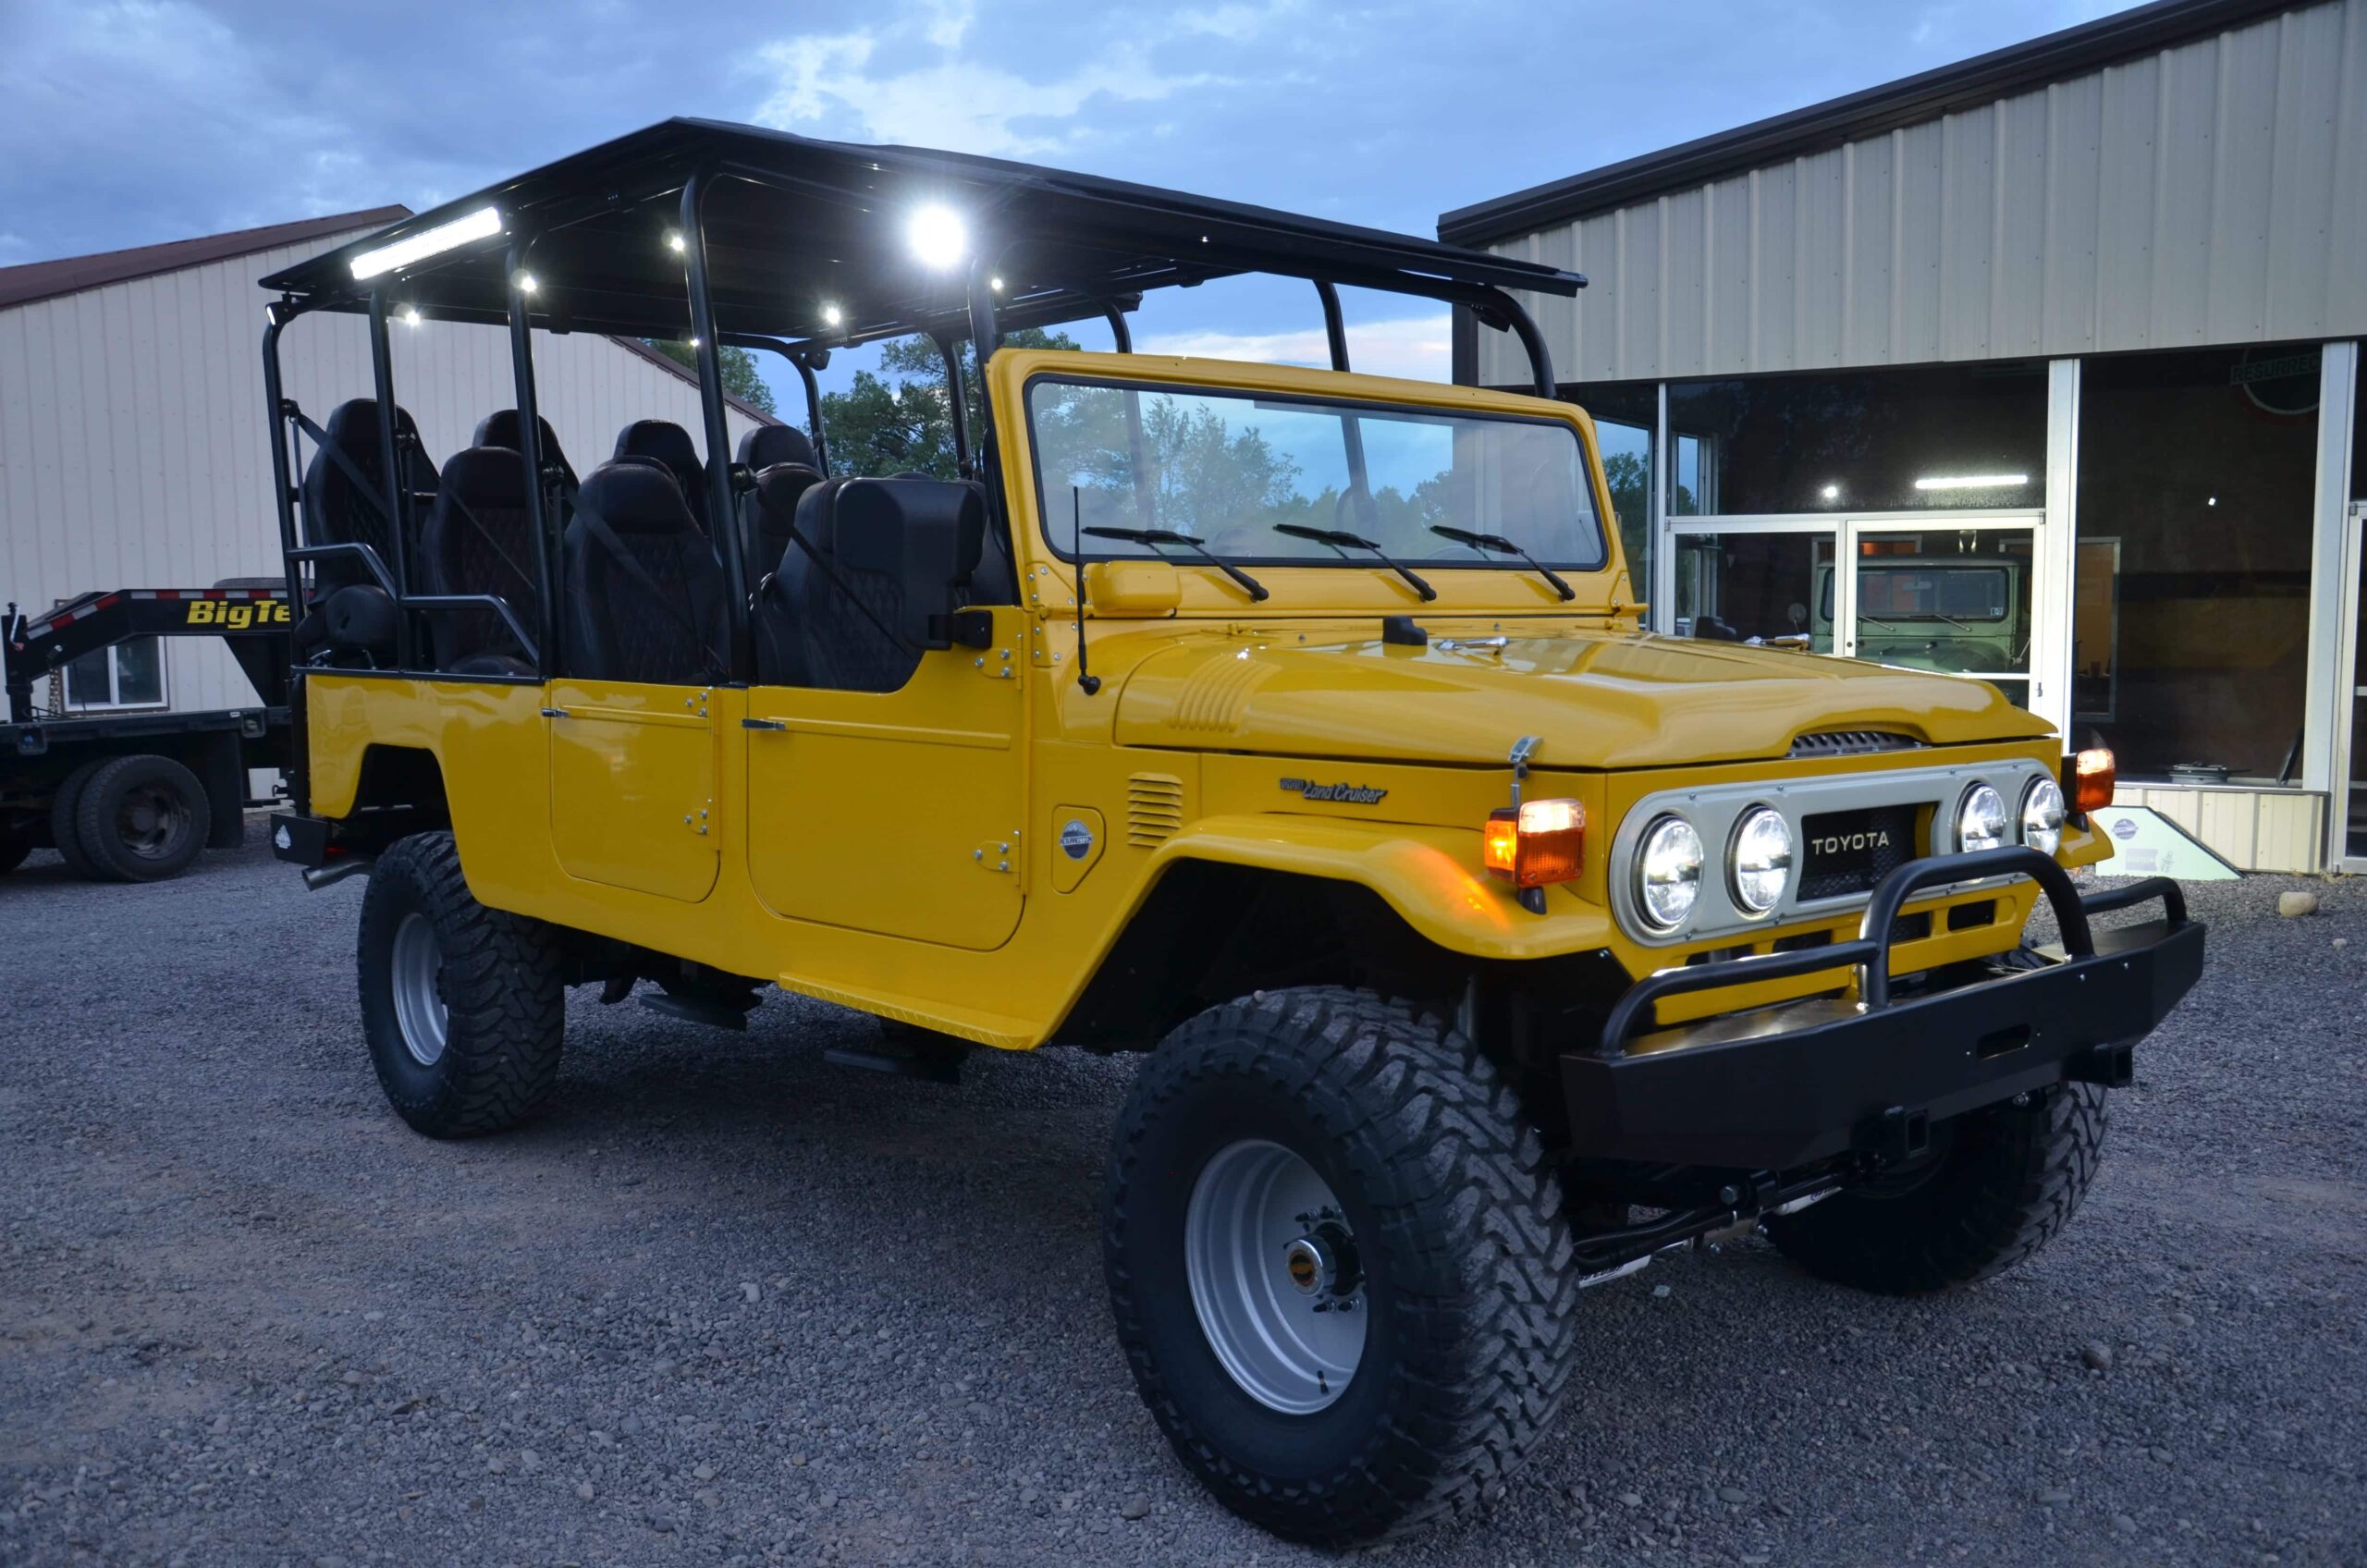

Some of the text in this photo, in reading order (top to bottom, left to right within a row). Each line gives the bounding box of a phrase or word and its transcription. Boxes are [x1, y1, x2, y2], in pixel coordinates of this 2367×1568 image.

[1303, 780, 1335, 801] Land
[1333, 782, 1387, 804] Cruiser
[1811, 831, 1890, 855] TOYOTA
